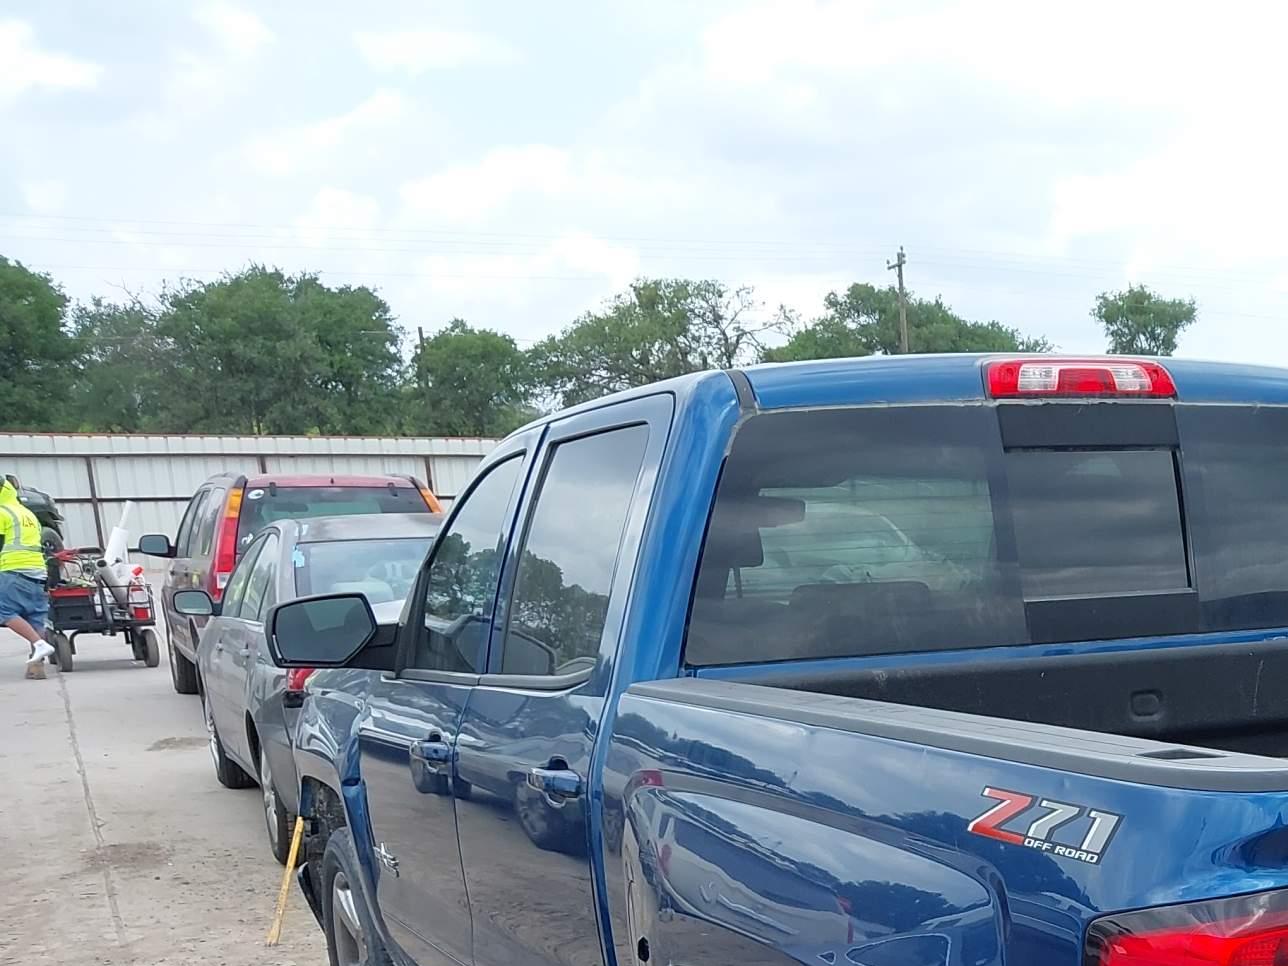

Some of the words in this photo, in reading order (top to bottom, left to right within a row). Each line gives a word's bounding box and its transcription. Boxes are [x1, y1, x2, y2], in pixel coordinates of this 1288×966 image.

[968, 785, 1124, 854] Z71
[1024, 838, 1052, 853] OFF
[1054, 845, 1099, 863] ROAD
